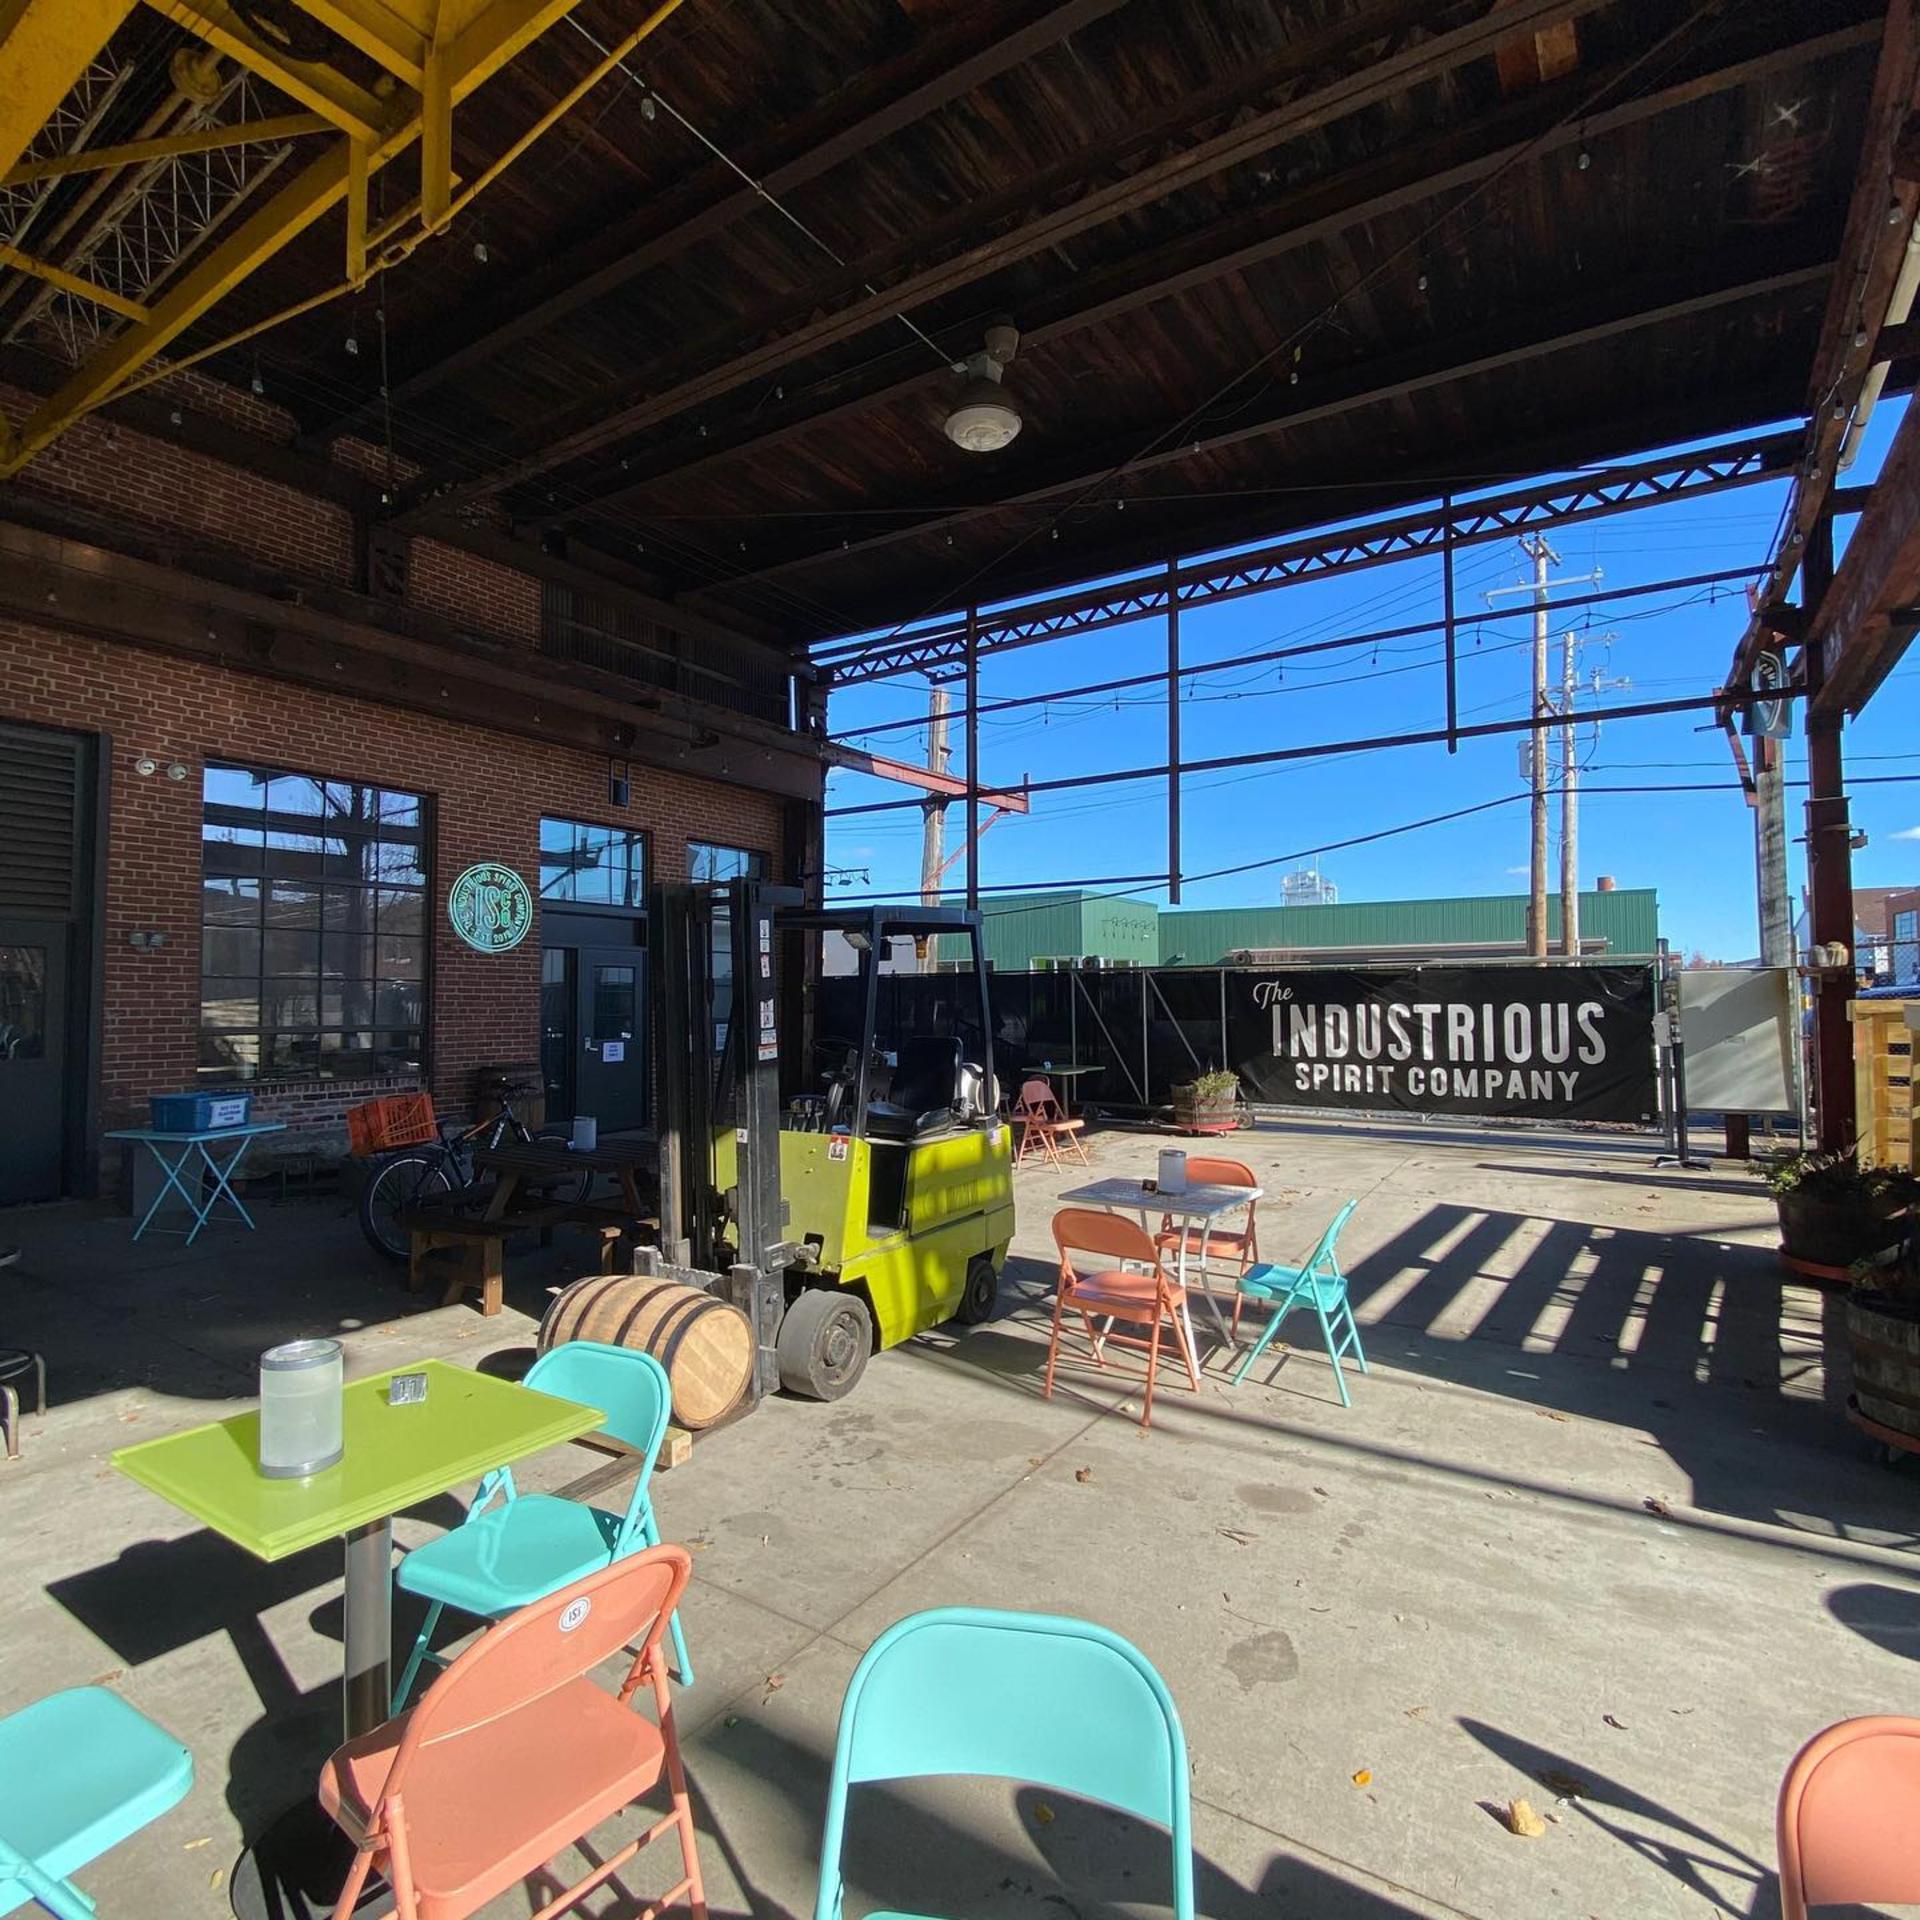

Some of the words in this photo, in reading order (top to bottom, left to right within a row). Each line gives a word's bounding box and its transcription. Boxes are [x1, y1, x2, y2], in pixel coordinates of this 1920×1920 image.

[1253, 981, 1293, 1009] The
[1272, 1001, 1606, 1065] INDUSTRIOUS
[1294, 1062, 1395, 1094] SPIRIT
[1407, 1066, 1580, 1101] COMPANY
